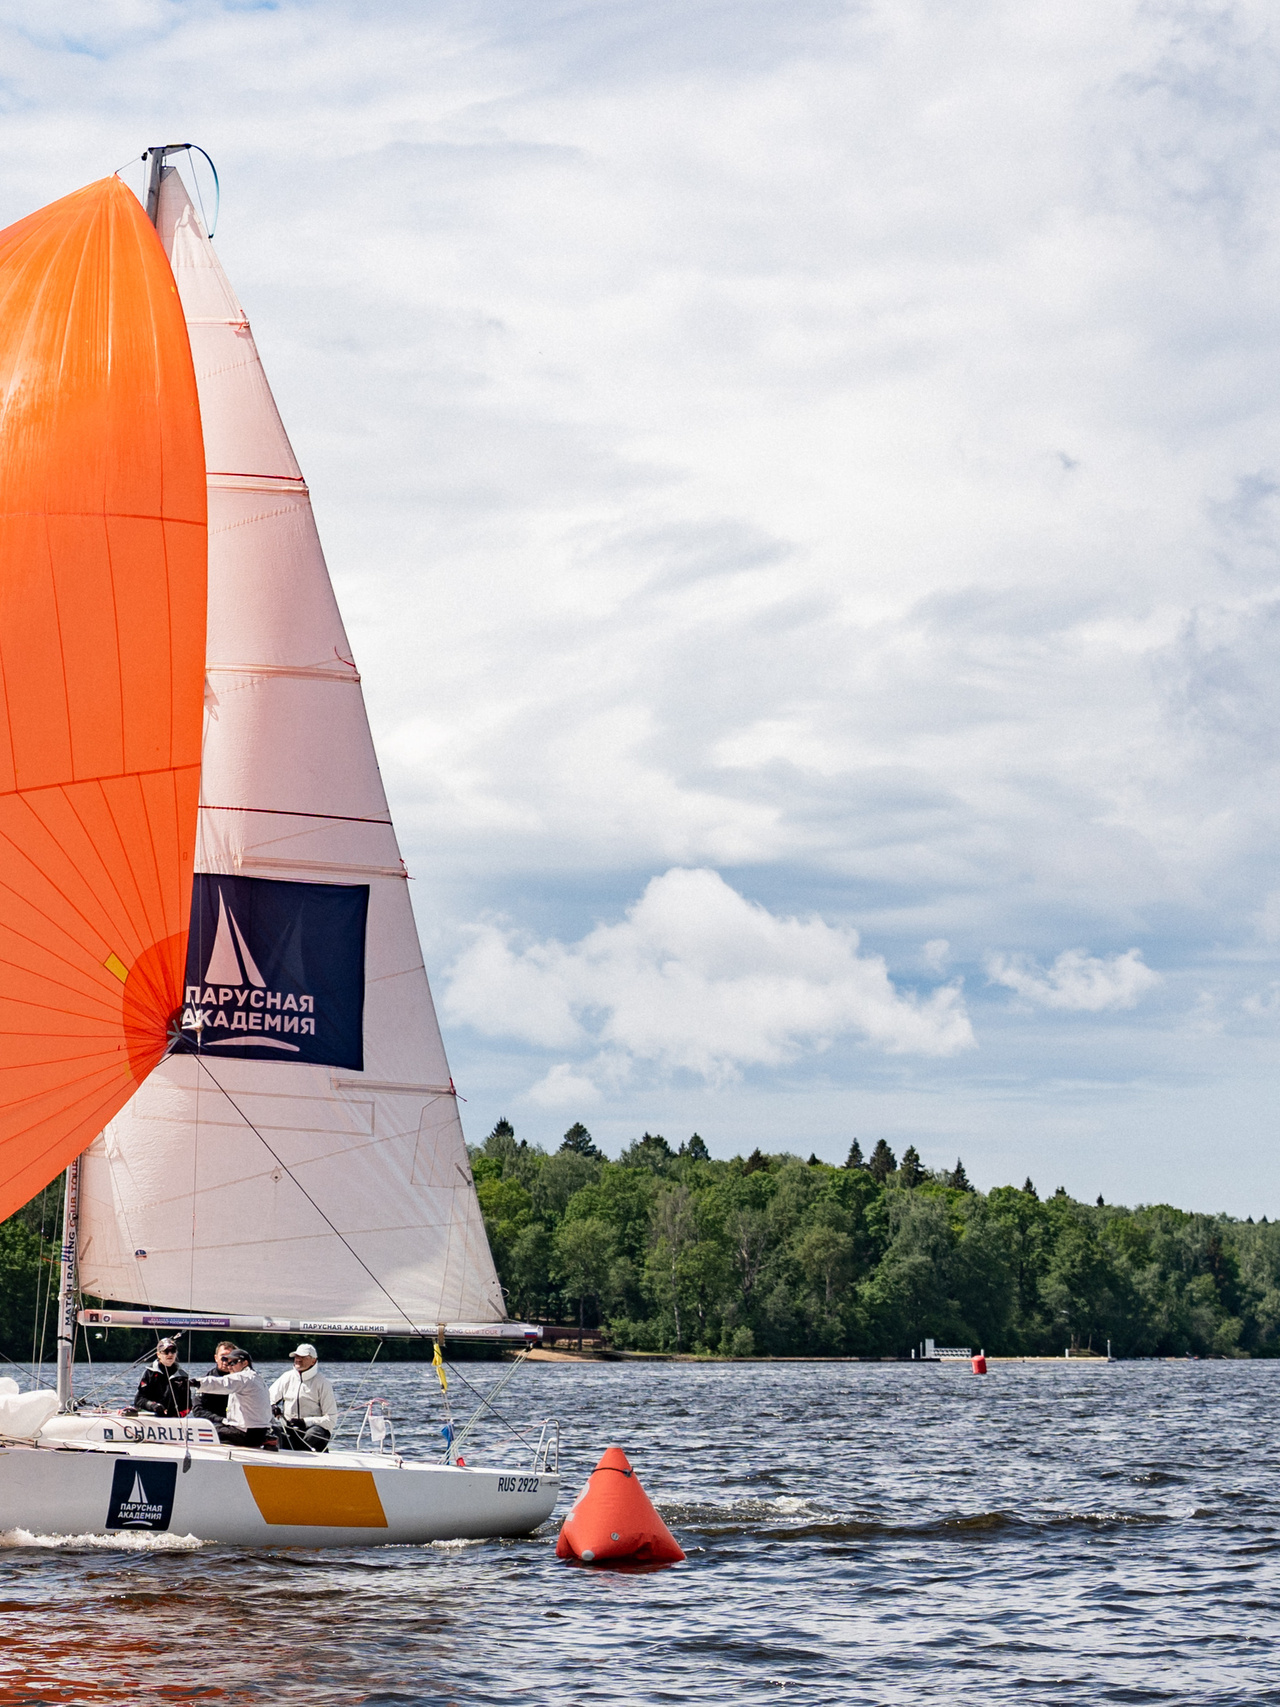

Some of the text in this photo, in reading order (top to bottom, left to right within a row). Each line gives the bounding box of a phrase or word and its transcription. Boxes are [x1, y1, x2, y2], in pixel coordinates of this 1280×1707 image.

[185, 985, 315, 1013] ПАРУСНАЯ
[182, 1007, 316, 1036] АКАДЕМИЯ
[303, 1322, 385, 1332] ПАРУСНАЯ АКАДЕМИЯ
[123, 1425, 194, 1442] CHARLIE
[498, 1477, 539, 1492] RUS 2922
[120, 1503, 163, 1512] ПАРУСНАЯ
[118, 1511, 162, 1520] АКАДЕМИЯ
